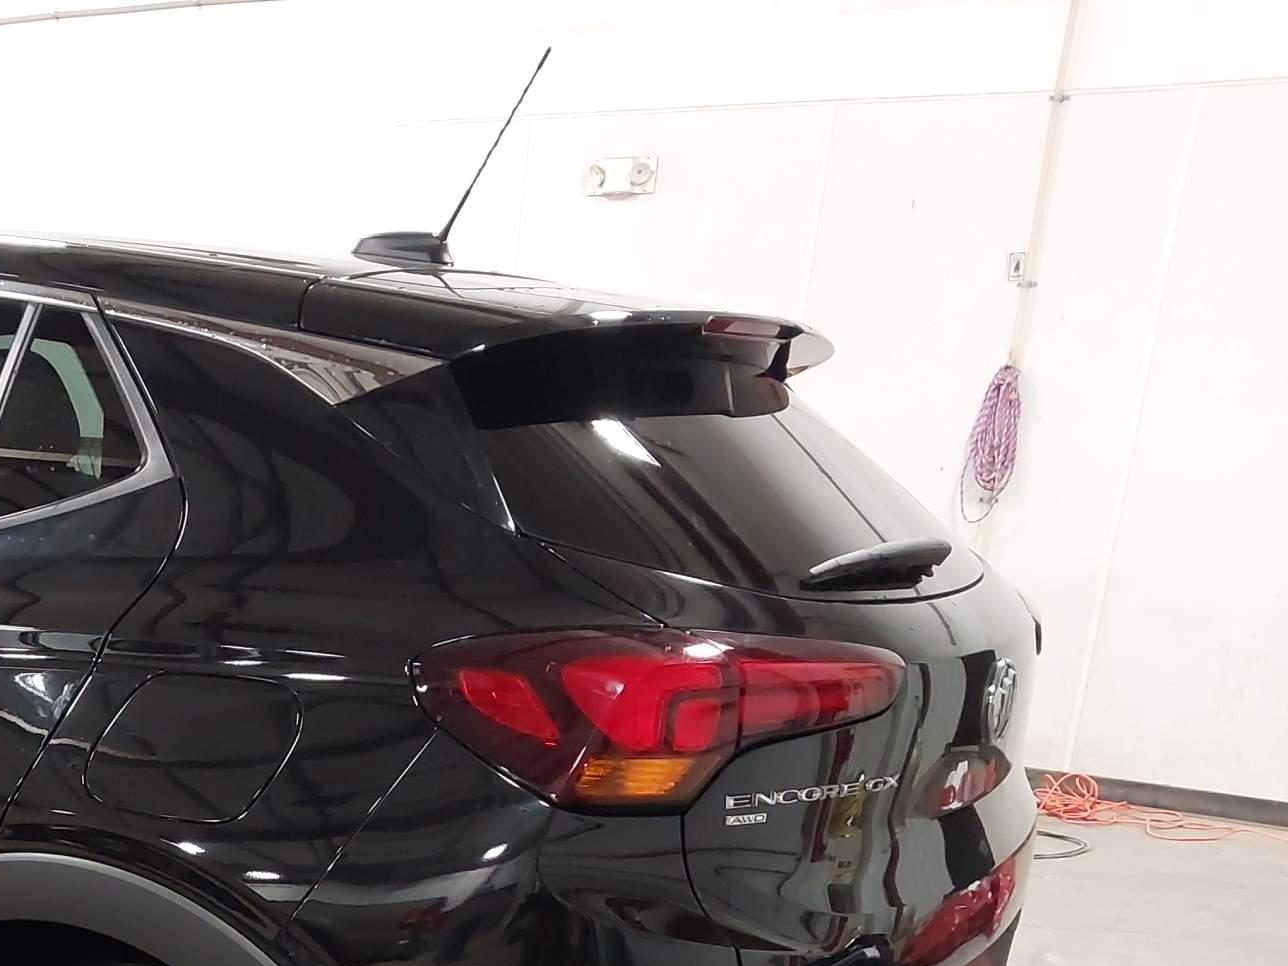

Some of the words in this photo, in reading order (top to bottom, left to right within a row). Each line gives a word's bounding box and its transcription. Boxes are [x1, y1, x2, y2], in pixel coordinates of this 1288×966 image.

[724, 782, 861, 810] ENCORE
[864, 774, 900, 793] GX
[726, 813, 768, 825] AWD
